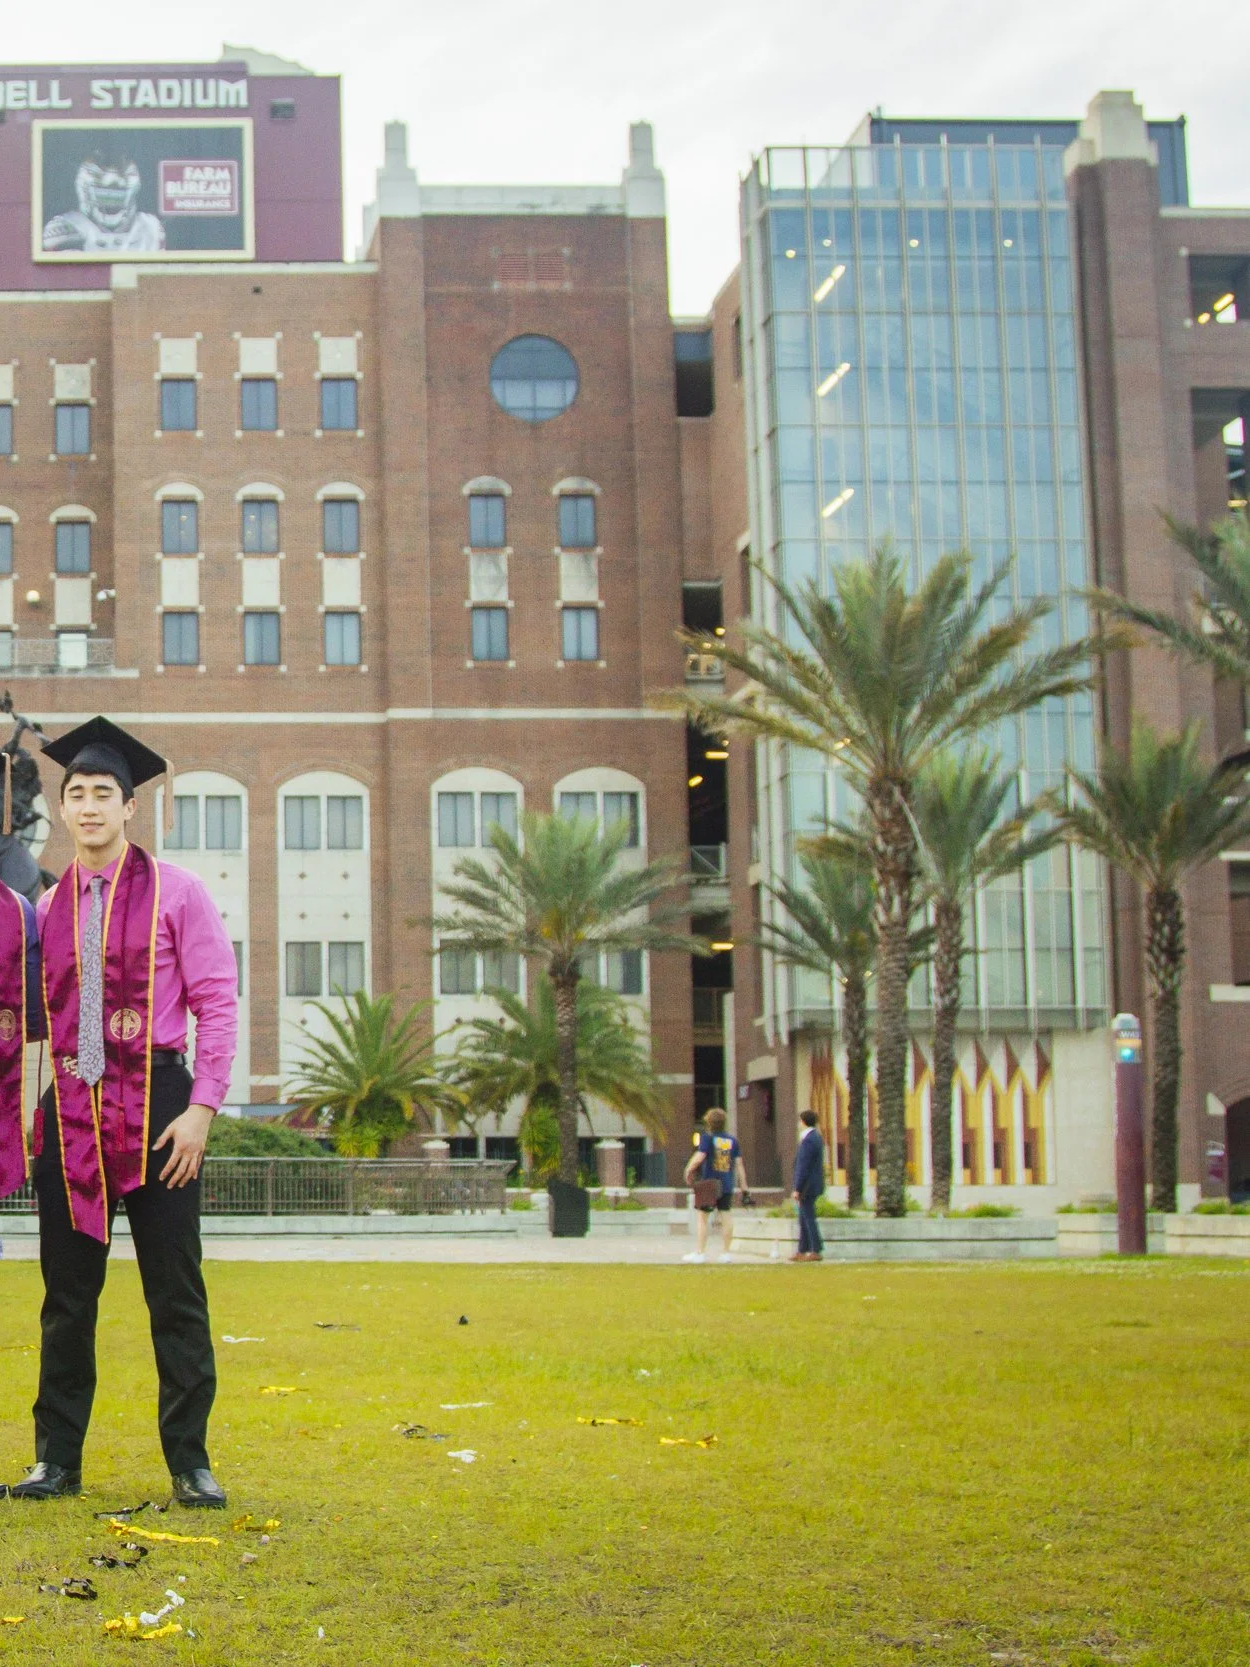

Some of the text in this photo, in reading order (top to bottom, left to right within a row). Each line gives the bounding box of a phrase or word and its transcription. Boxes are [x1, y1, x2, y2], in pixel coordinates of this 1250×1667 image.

[90, 78, 249, 110] STADIUM
[182, 166, 231, 180] FARM
[165, 181, 231, 195] BUREAU
[174, 199, 231, 209] INSURANCE
